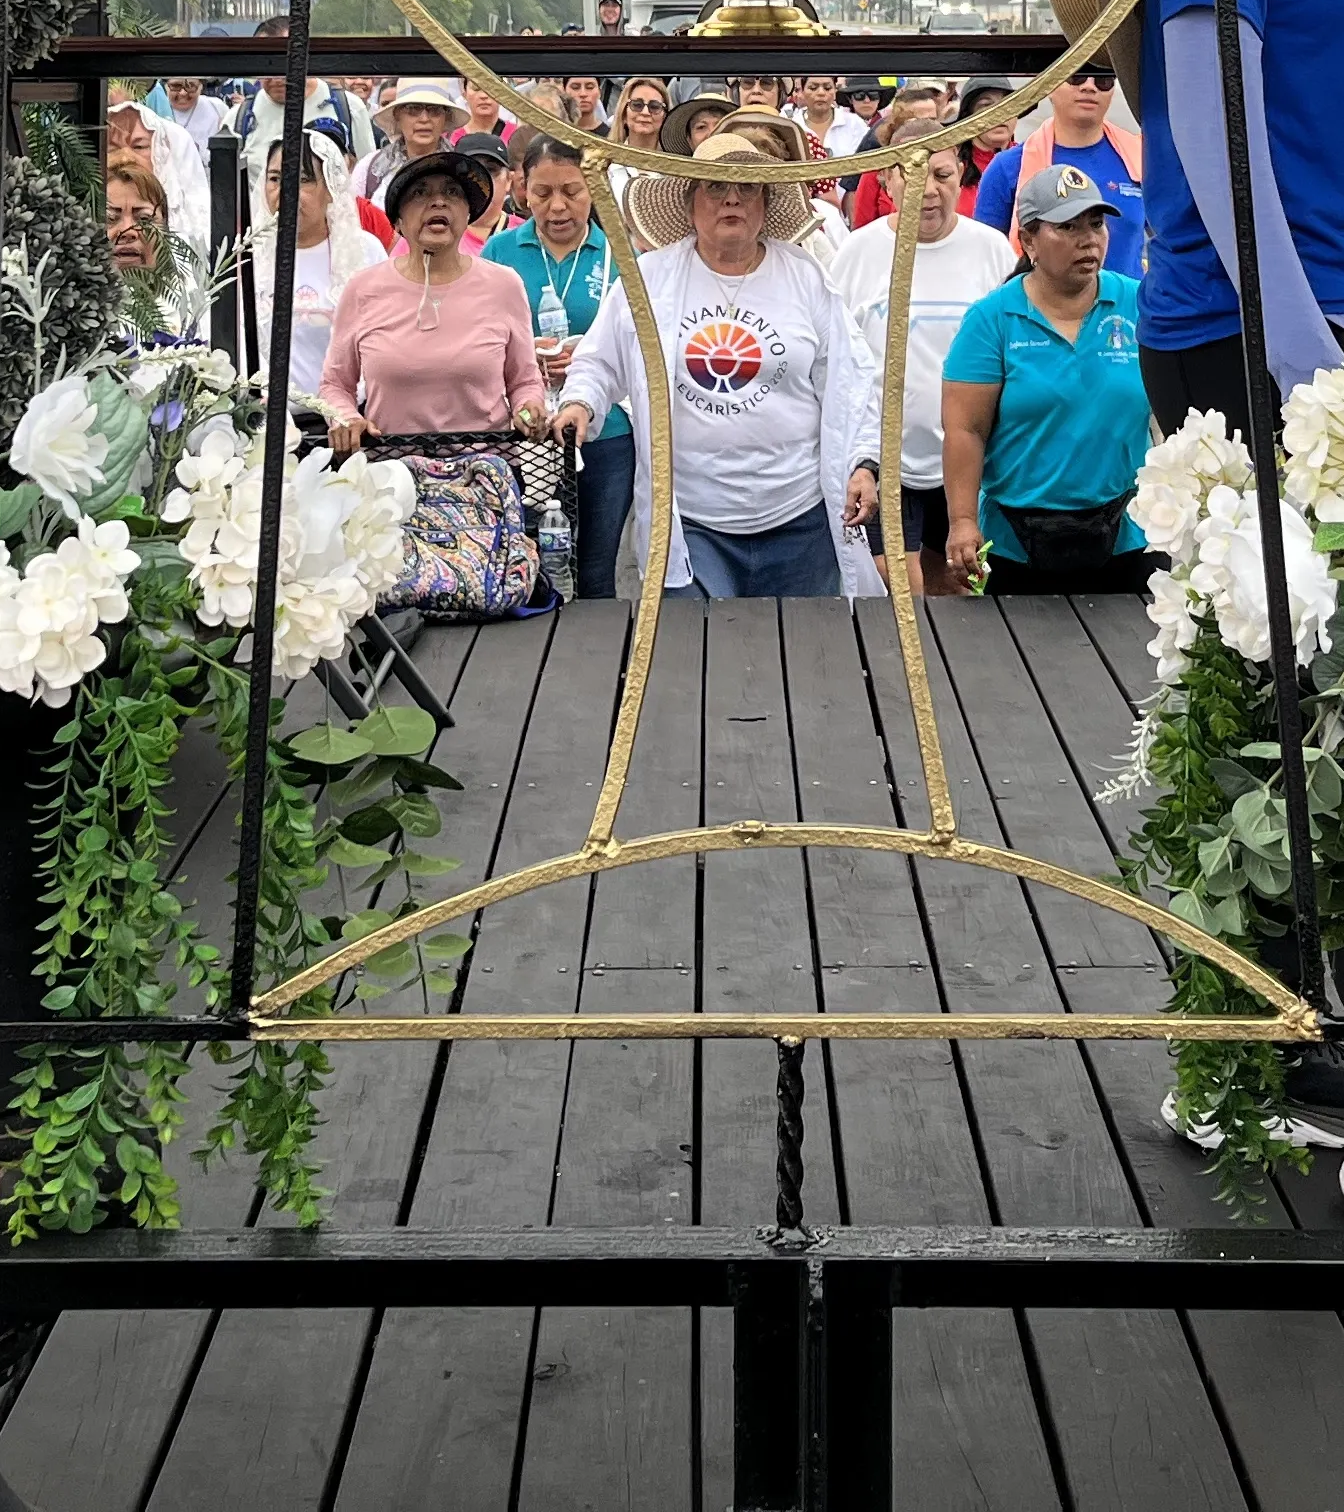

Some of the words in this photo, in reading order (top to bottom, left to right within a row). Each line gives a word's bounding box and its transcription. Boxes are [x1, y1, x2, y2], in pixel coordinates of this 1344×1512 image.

[678, 305, 786, 356] IVAMIENTO
[676, 383, 771, 416] EUCARÍSTICO
[770, 360, 788, 385] 2025
